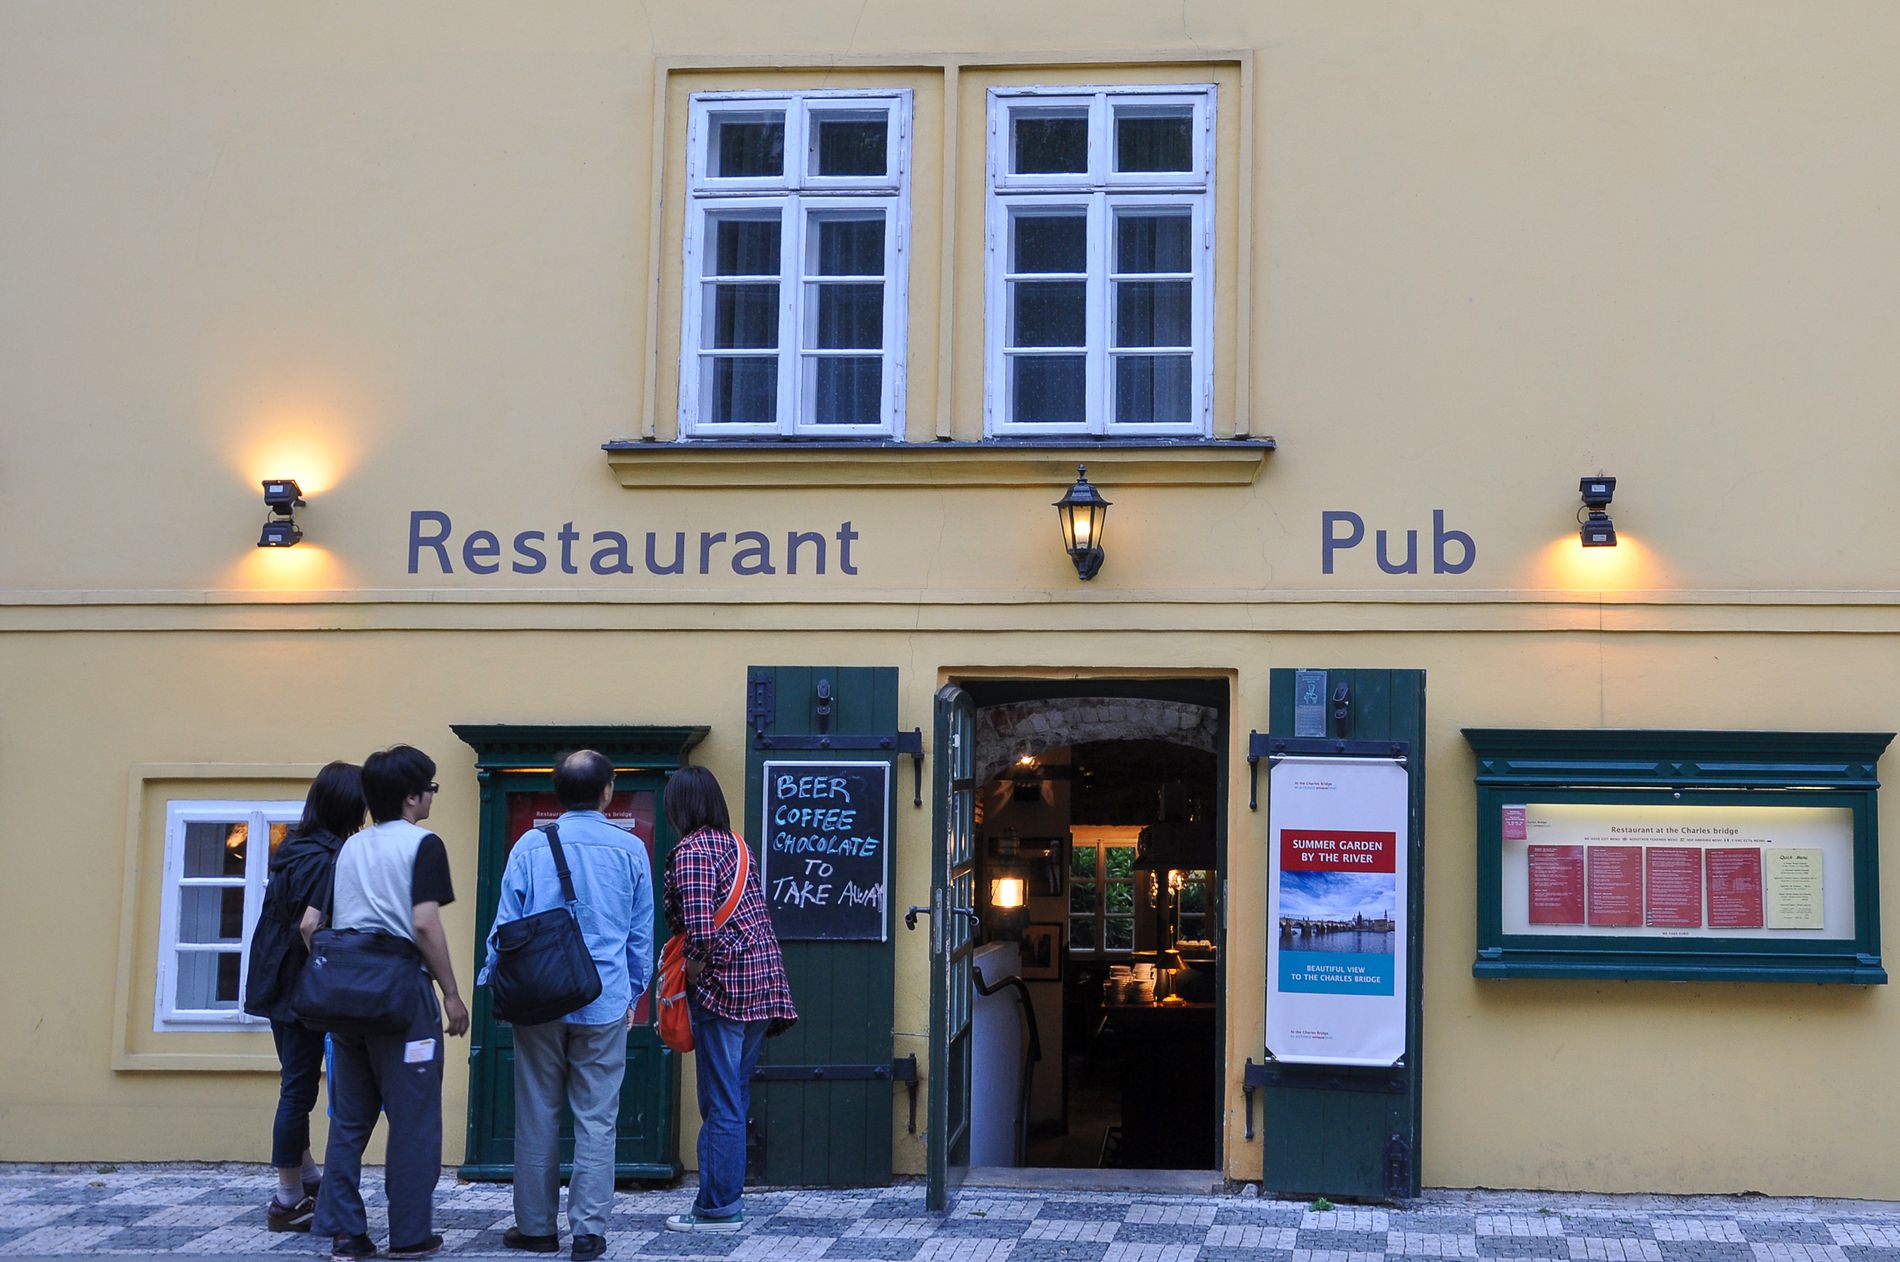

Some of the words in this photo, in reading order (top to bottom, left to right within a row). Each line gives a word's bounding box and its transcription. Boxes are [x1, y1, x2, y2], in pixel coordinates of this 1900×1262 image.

[407, 510, 859, 575] Restaurant
[1322, 509, 1476, 575] Pub
[776, 774, 850, 803] BEER
[612, 811, 633, 819] bridge
[774, 804, 857, 832] COFFEE
[1611, 826, 1654, 834] Restaurant
[1666, 826, 1679, 834] the
[1681, 826, 1711, 834] Charles
[1713, 827, 1739, 836] bridge
[772, 831, 880, 857] CHOCOLATE
[1292, 839, 1336, 850] SUMMER
[1339, 840, 1383, 851] GARDEN
[1301, 852, 1315, 862] BY
[1318, 852, 1339, 863] THE
[1342, 853, 1374, 864] RIVER
[805, 859, 834, 877] TO
[773, 876, 832, 908] TAKE
[837, 880, 884, 912] AWAY
[1291, 973, 1302, 981] TO
[1320, 974, 1352, 982] CHARLES
[1306, 965, 1345, 973] BEAUTIFUL
[1347, 966, 1366, 974] VIEW
